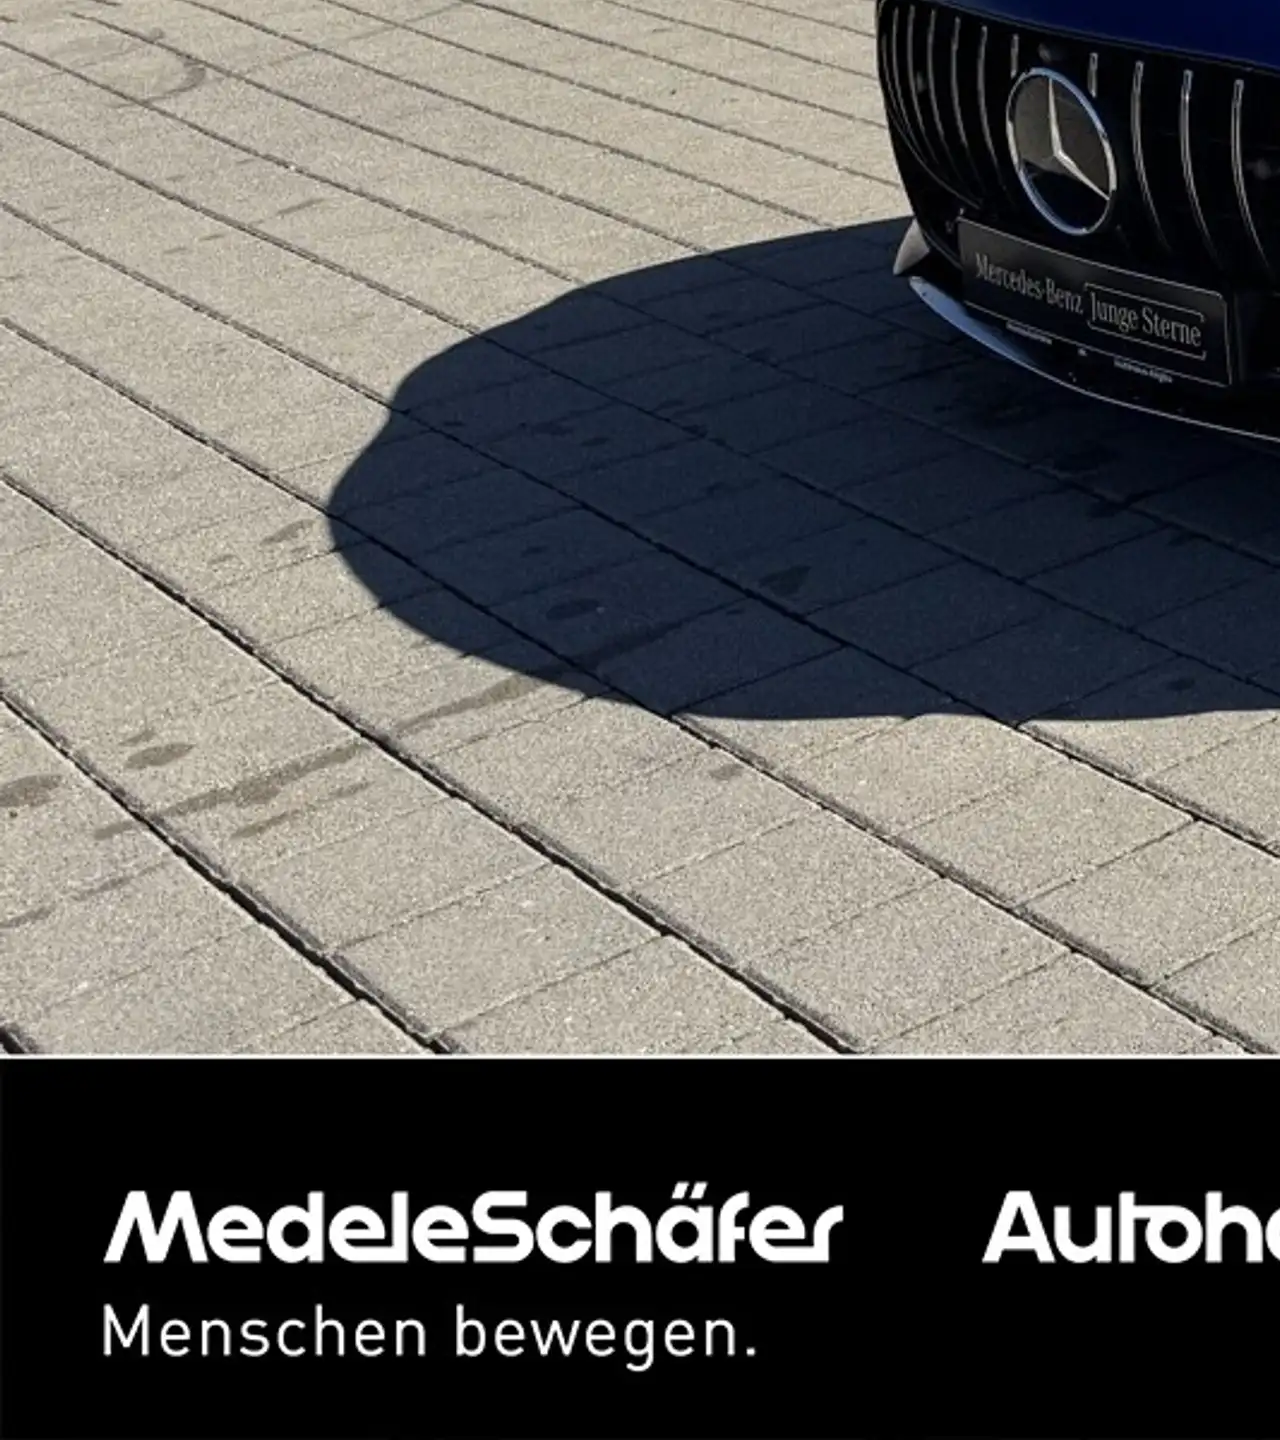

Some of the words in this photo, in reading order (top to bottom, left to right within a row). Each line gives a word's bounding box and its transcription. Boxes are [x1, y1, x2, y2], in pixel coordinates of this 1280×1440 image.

[975, 252, 1084, 314] Mercedes-Benz
[1090, 291, 1139, 333] Junge
[1142, 308, 1201, 347] Sterne
